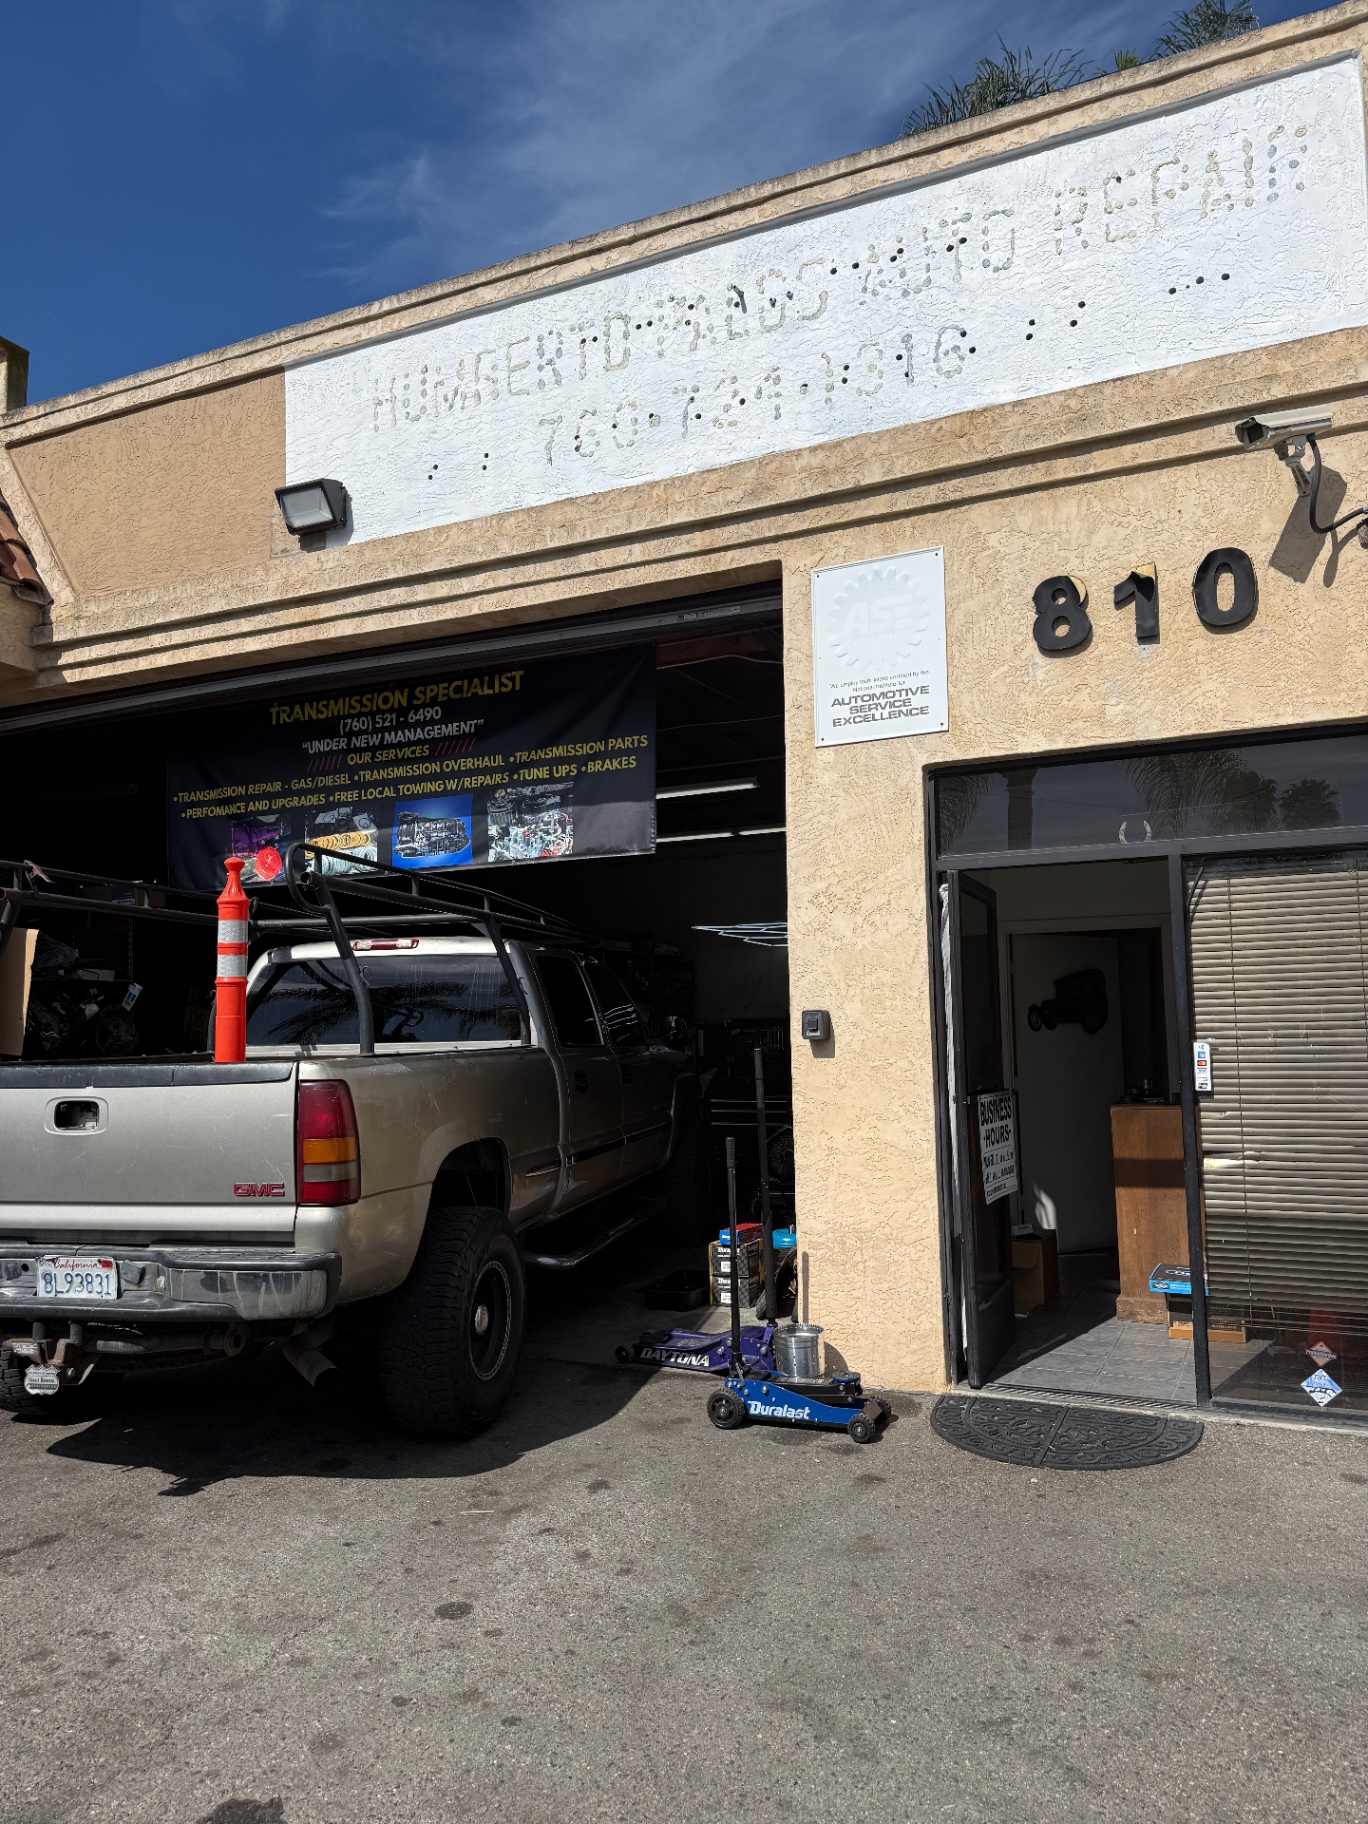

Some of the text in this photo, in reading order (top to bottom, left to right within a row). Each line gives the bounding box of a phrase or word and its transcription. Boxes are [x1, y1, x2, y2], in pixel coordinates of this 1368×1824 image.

[1032, 547, 1259, 651] 810
[269, 670, 524, 726] TRANSMISSION SPECIALIST
[831, 685, 930, 708] AUTOMOTIVE
[849, 697, 913, 715] SERVICE
[339, 715, 373, 736] (760)
[375, 712, 397, 728] 521
[407, 706, 442, 723] 6490
[832, 705, 930, 727] EXCELLENCE
[350, 732, 382, 749] NEW
[247, 781, 283, 796] REPAIR
[290, 773, 352, 789] GAS/DIESEL
[442, 754, 505, 773] OVERHAUL
[607, 734, 649, 751] PARTS
[347, 745, 431, 766] OUR SERVICES
[247, 800, 270, 812] AND
[271, 793, 326, 810] UPGRADES
[361, 785, 397, 800] LOCAL
[398, 779, 444, 796] TOWING
[445, 772, 510, 791] W/REPAIRS
[552, 764, 578, 778] UPS
[980, 1096, 1012, 1127] BUSINESS
[233, 1183, 286, 1198] GMC
[53, 1259, 99, 1272] California
[43, 1272, 112, 1296] 8L93831
[640, 1347, 710, 1367] DAYTONA
[747, 1401, 811, 1420] Duralast
